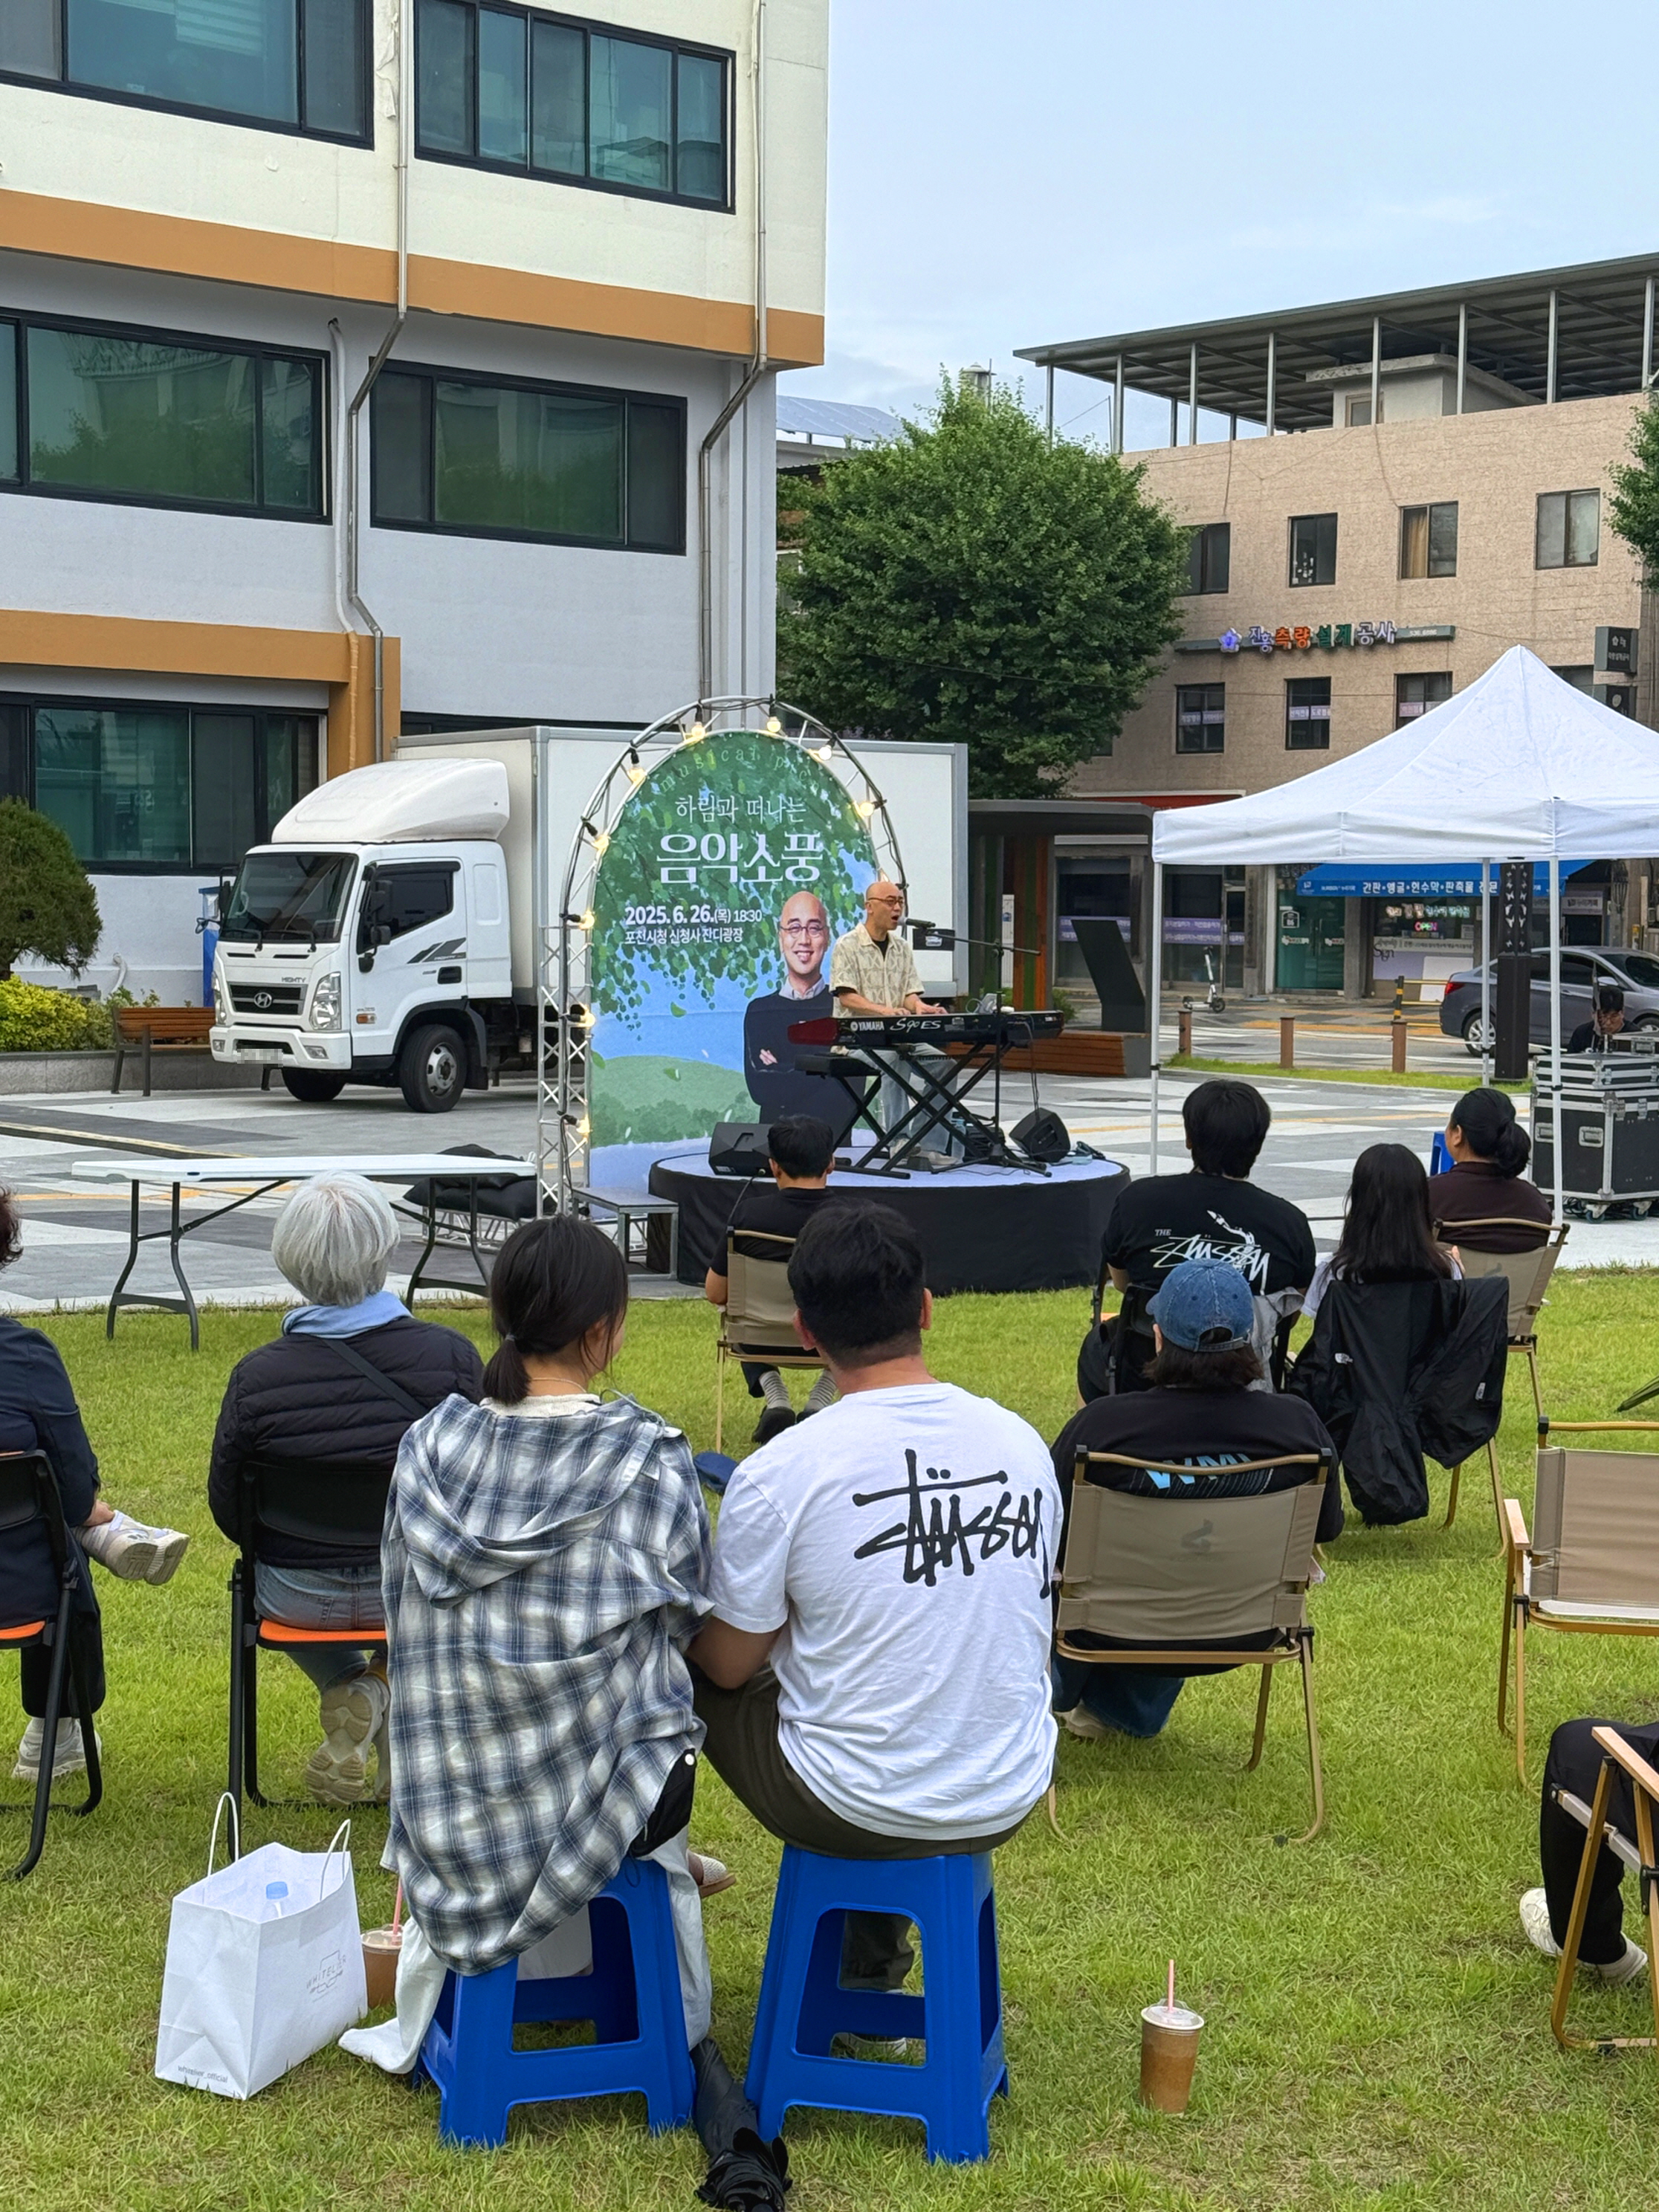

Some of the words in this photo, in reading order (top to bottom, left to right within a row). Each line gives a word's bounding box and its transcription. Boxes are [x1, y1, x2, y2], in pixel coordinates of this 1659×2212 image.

[675, 795, 739, 824] 하림과
[747, 795, 806, 824] 떠나는
[656, 830, 824, 884] 음악소풍
[624, 905, 670, 925] 2025.
[673, 905, 688, 924] 6.
[1414, 921, 1438, 931] OPEN
[624, 929, 667, 945] 포천시청
[669, 928, 701, 944] 신청사
[702, 927, 743, 943] 잔디광장
[858, 1021, 885, 1031] YAMAHA
[1154, 1229, 1172, 1237] THE
